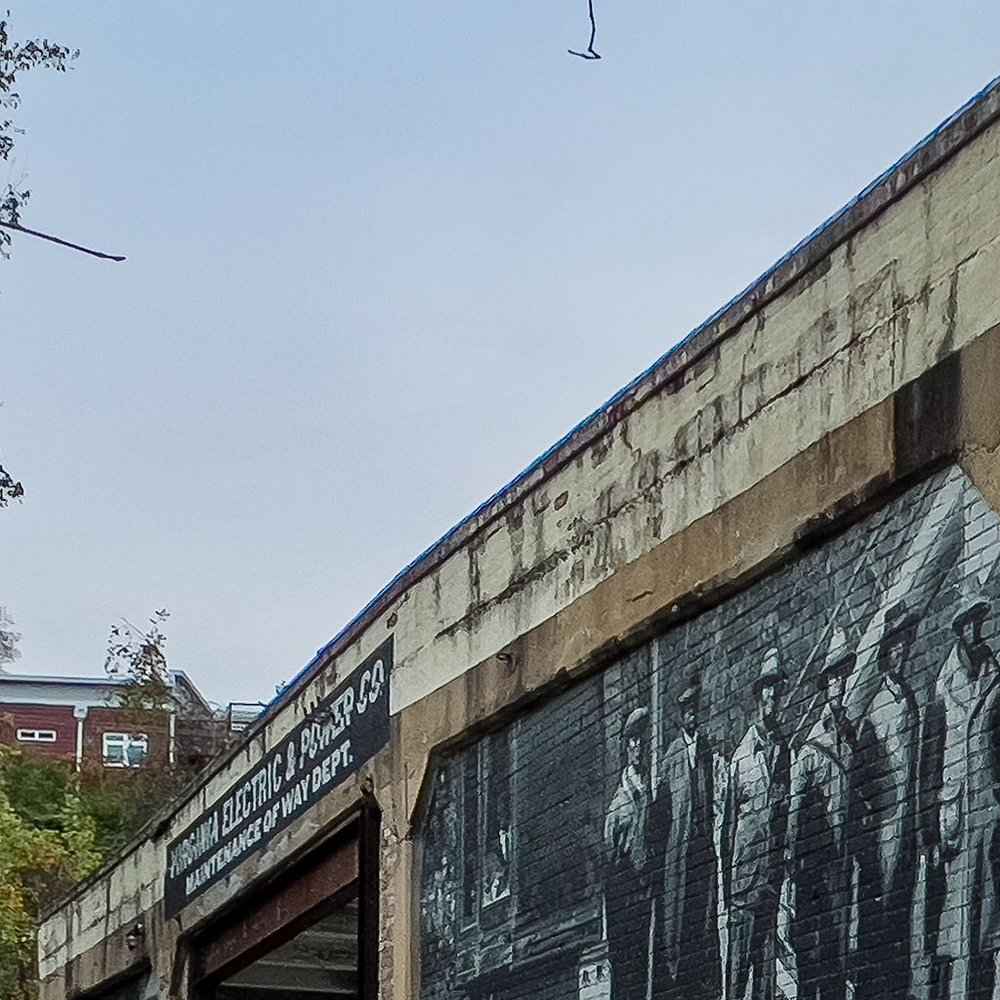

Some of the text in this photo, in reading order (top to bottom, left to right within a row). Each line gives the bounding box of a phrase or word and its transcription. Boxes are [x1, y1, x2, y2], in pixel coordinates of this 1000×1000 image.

[168, 659, 383, 878] VIRGINIA ELECTRIC & POWER CO.
[185, 739, 353, 895] MAINTENANCE OF WAY DEPT.
